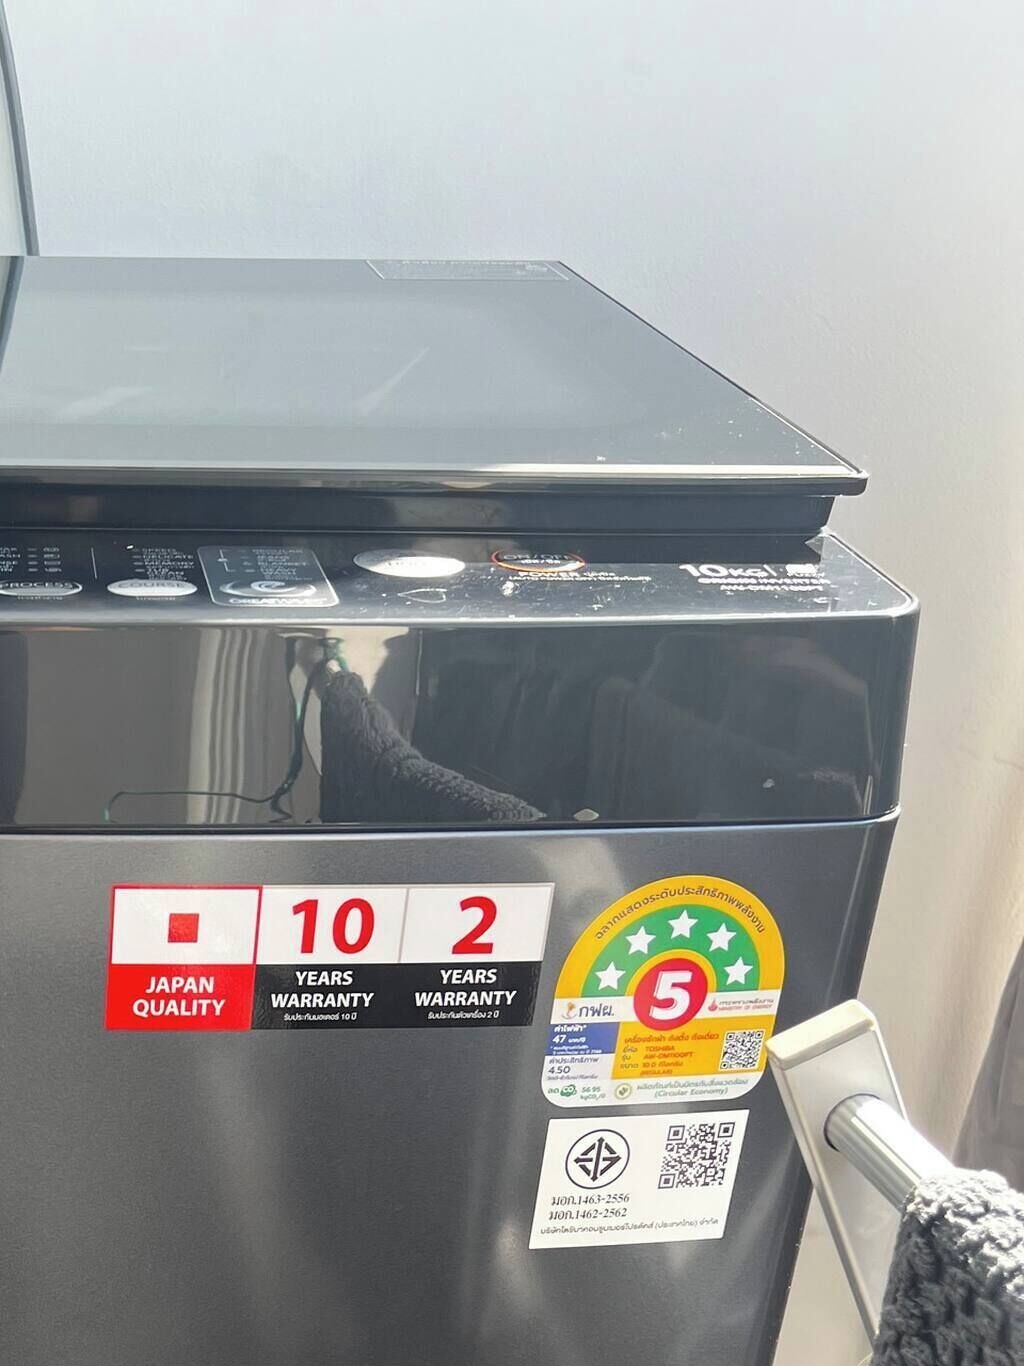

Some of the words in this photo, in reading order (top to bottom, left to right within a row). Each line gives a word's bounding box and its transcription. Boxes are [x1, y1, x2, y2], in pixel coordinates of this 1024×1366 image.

[291, 897, 376, 955] 10
[451, 895, 498, 955] 2
[295, 970, 354, 986] YEARS
[440, 968, 498, 983] YEARS
[145, 976, 215, 994] JAPAN
[270, 992, 375, 1009] WARRANTY
[414, 990, 518, 1007] WARRANTY
[648, 970, 694, 1022] 5
[132, 998, 226, 1019] QUALITY
[351, 1011, 358, 1020] ปี
[493, 1010, 500, 1019] ปี
[552, 1034, 566, 1044] 47
[654, 1088, 687, 1099] (Circular
[689, 1086, 729, 1098] Economy)
[548, 1206, 628, 1221] มอก.1462-2562
